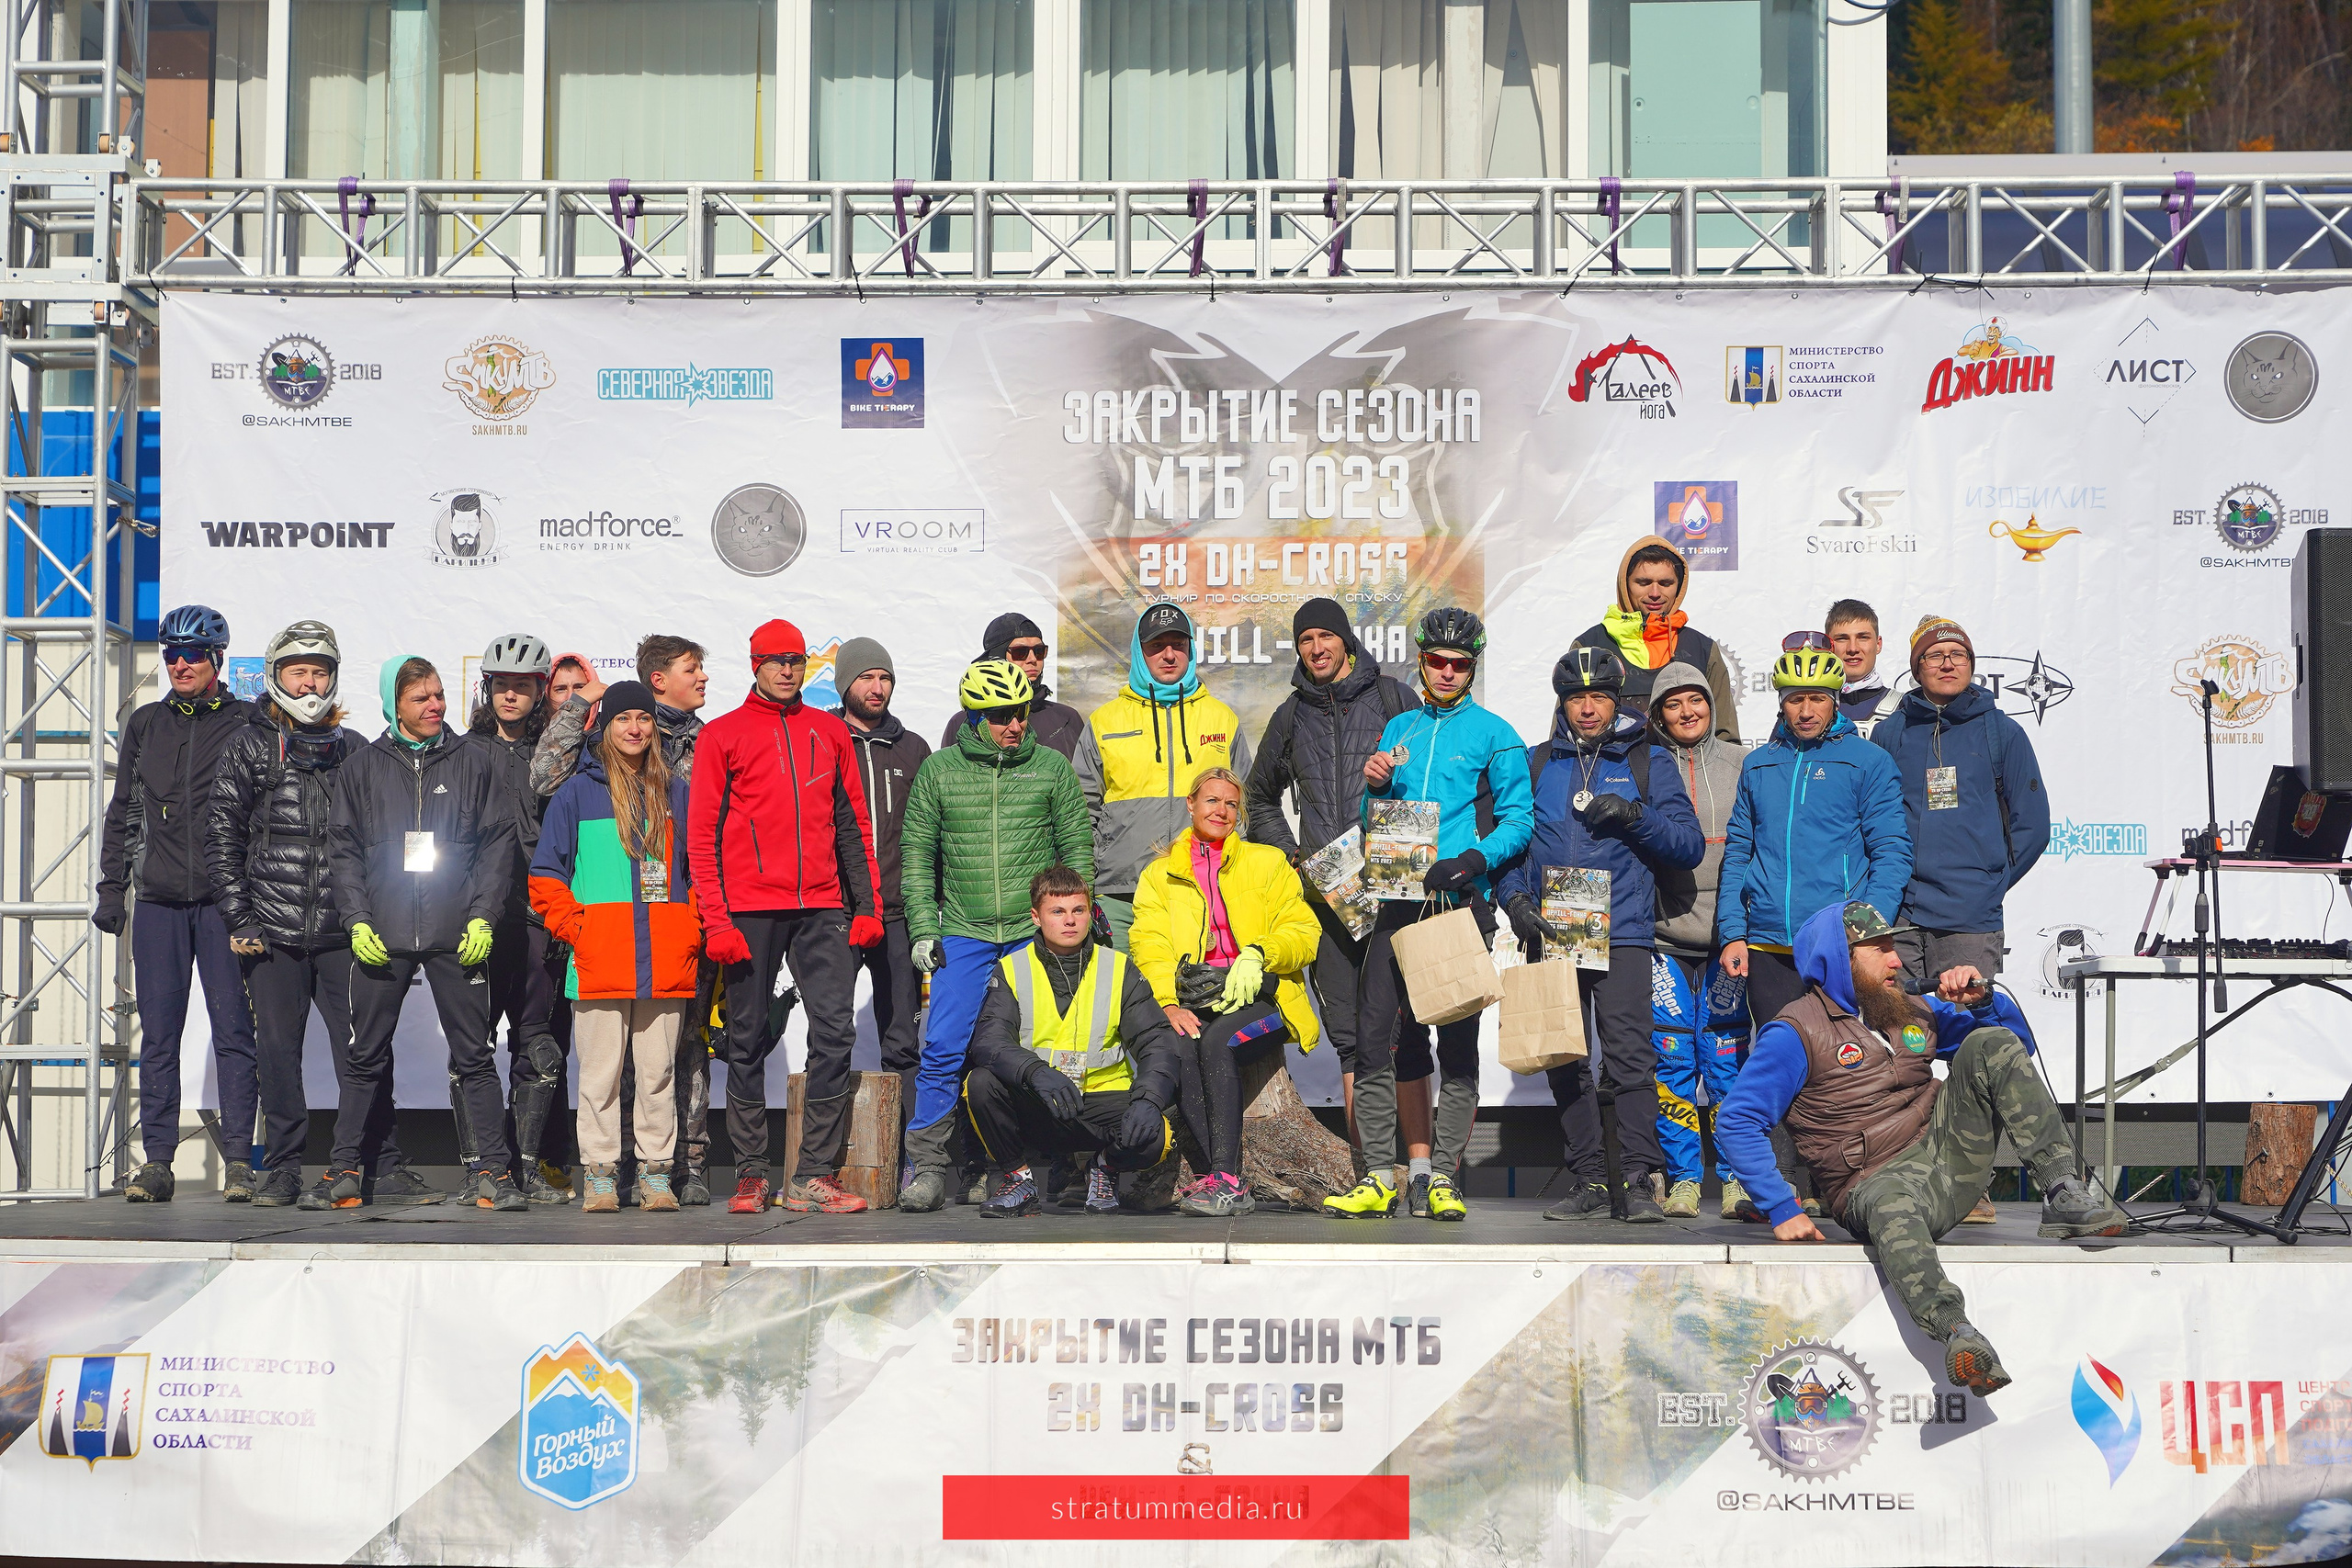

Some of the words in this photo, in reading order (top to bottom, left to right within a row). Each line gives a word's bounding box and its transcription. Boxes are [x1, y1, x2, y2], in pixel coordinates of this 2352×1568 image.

[1789, 345, 1884, 356] МИНИСТЕРСТВО
[211, 363, 253, 379] EST.
[340, 364, 381, 380] 2018
[1789, 361, 1836, 370] СПОРТА
[2106, 359, 2184, 382] ЛИСТ
[599, 370, 684, 398] СЕВЕРНАЯ
[707, 370, 772, 398] ЗВЕЗДА
[1789, 372, 1876, 384] САХАЛИНСКОЙ
[1921, 355, 2055, 415] ДЖИНН
[1789, 388, 1843, 398] ОБЛАСТИ
[242, 414, 352, 427] @SAKHMTBE
[1064, 389, 1298, 444] ЗАКРЫТИЕ
[1317, 388, 1482, 443] СЕЗОНА
[471, 424, 528, 435] SAKHMTB.RU
[1134, 457, 1244, 519] МТБ
[1268, 456, 1409, 519] 2023
[1964, 486, 2107, 510] ИЗОБИЛИЕ
[2173, 510, 2210, 525] EST.
[2290, 509, 2328, 525] 2018
[854, 521, 971, 538] VROOM
[1206, 542, 1408, 587] DH-CROSS
[1143, 593, 1198, 604] ТУРНИР
[1204, 593, 1225, 604] ПО
[1231, 593, 1339, 604] СКОРОСТНОМУ
[1345, 592, 1403, 603] СПУСКУ
[1151, 609, 1179, 622] FOX
[1200, 733, 1226, 746] ДЖИНН
[2084, 825, 2146, 854] ЗВЕЗДА
[1419, 845, 1428, 863] 1
[1590, 912, 1602, 931] 3
[952, 1317, 1168, 1364] ЗАКРЫТИЕ
[1185, 1317, 1340, 1364] СЕЗОНА
[1351, 1315, 1442, 1366] МТБ
[160, 1357, 335, 1376] МИНИСТЕРСТВО
[158, 1382, 243, 1398] СПОРТА
[2298, 1381, 2350, 1394] ЦЕНТР
[1122, 1382, 1344, 1432] DH-CROSS
[1658, 1393, 1736, 1426] EST.
[1890, 1393, 1967, 1425] 2018
[155, 1407, 316, 1427] САХАЛИНСКОЙ
[534, 1415, 616, 1457] Горный
[2159, 1381, 2290, 1474] ЦСП
[153, 1434, 252, 1450] ОБЛАСТИ
[536, 1438, 626, 1479] Воздух
[1716, 1490, 1916, 1511] @SAKHMTBE
